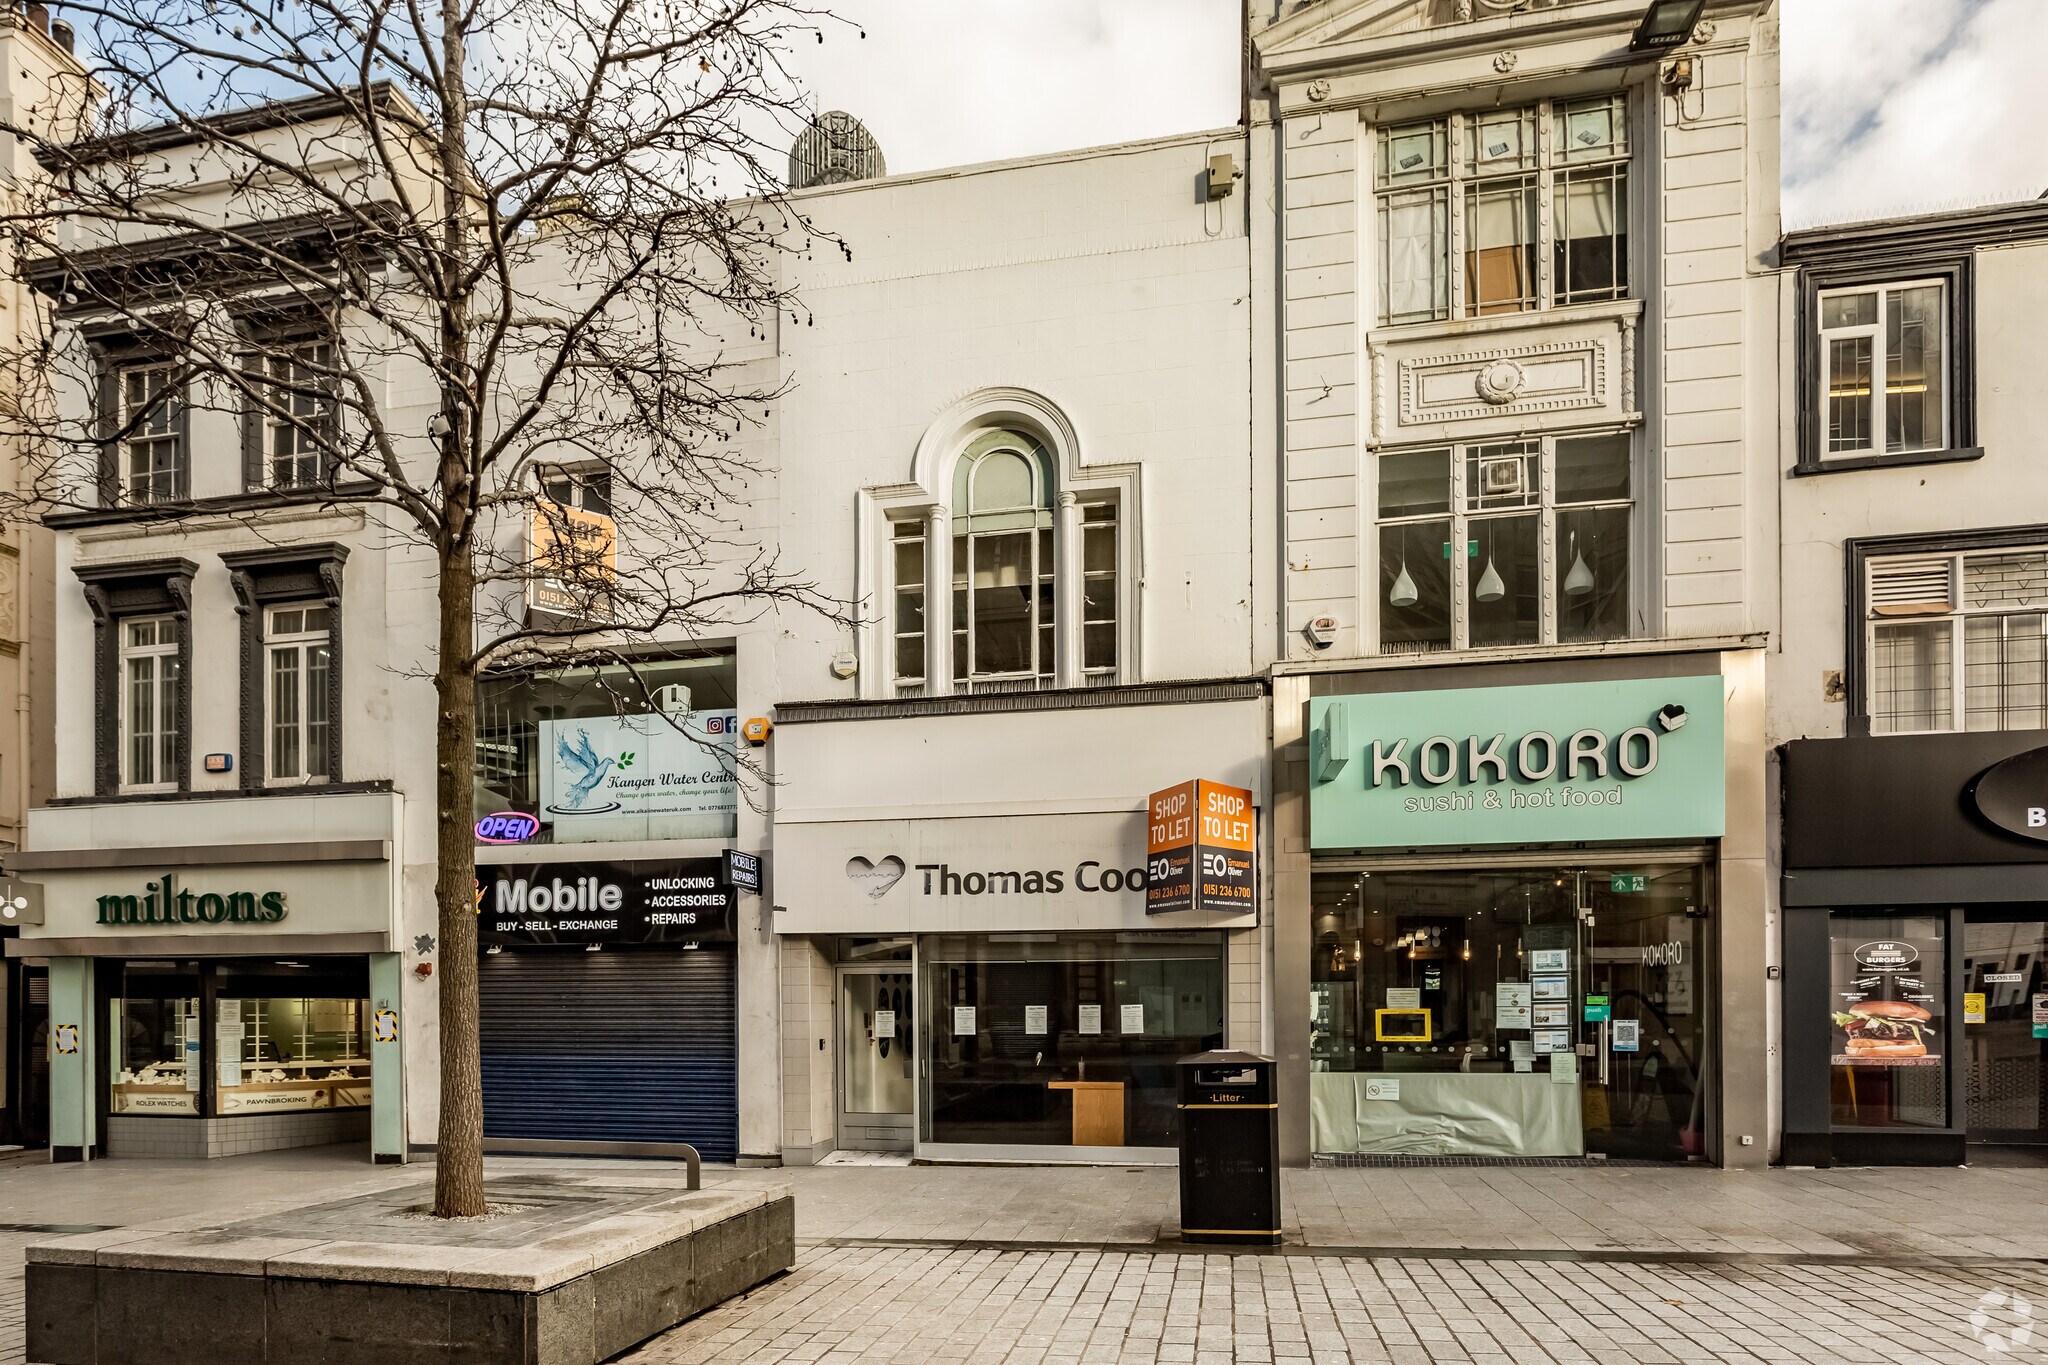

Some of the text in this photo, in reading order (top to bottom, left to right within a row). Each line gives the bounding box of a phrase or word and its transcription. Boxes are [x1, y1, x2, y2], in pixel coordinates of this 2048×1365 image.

[540, 590, 560, 603] 0151
[1372, 726, 1660, 786] KOKORO
[607, 776, 655, 790] Kangen
[660, 773, 698, 786] Water
[616, 791, 639, 799] Change
[640, 791, 655, 799] your
[679, 788, 701, 797] change
[703, 788, 718, 796] your
[720, 787, 734, 796] life!
[1404, 785, 1623, 813] sushi & hot food
[1155, 793, 1187, 820] SHOP
[1207, 791, 1245, 817] SHOP
[478, 816, 533, 839] OPEN
[1151, 817, 1191, 844] TO LET
[1203, 816, 1249, 842] TO LET
[731, 854, 755, 871] MOBILE
[1227, 857, 1250, 869] Emanuel
[732, 869, 755, 884] REPAIRS
[915, 863, 1064, 895] Thomas
[1227, 866, 1243, 876] Oliver
[651, 877, 715, 890] UNLOCKING
[1162, 886, 1173, 898] 236
[1174, 884, 1190, 897] 6700
[1203, 883, 1251, 898] 0151 236 6700
[96, 873, 289, 924] miltons
[495, 876, 623, 914] Mobile
[651, 894, 727, 907] ACCESSORIES
[496, 919, 618, 931] BUY SELL EXCHANGE
[651, 913, 696, 925] REPAIRS
[1642, 941, 1682, 967] KOKORO
[246, 1096, 307, 1105] PAWNBROKING
[1213, 1094, 1240, 1102] Litter
